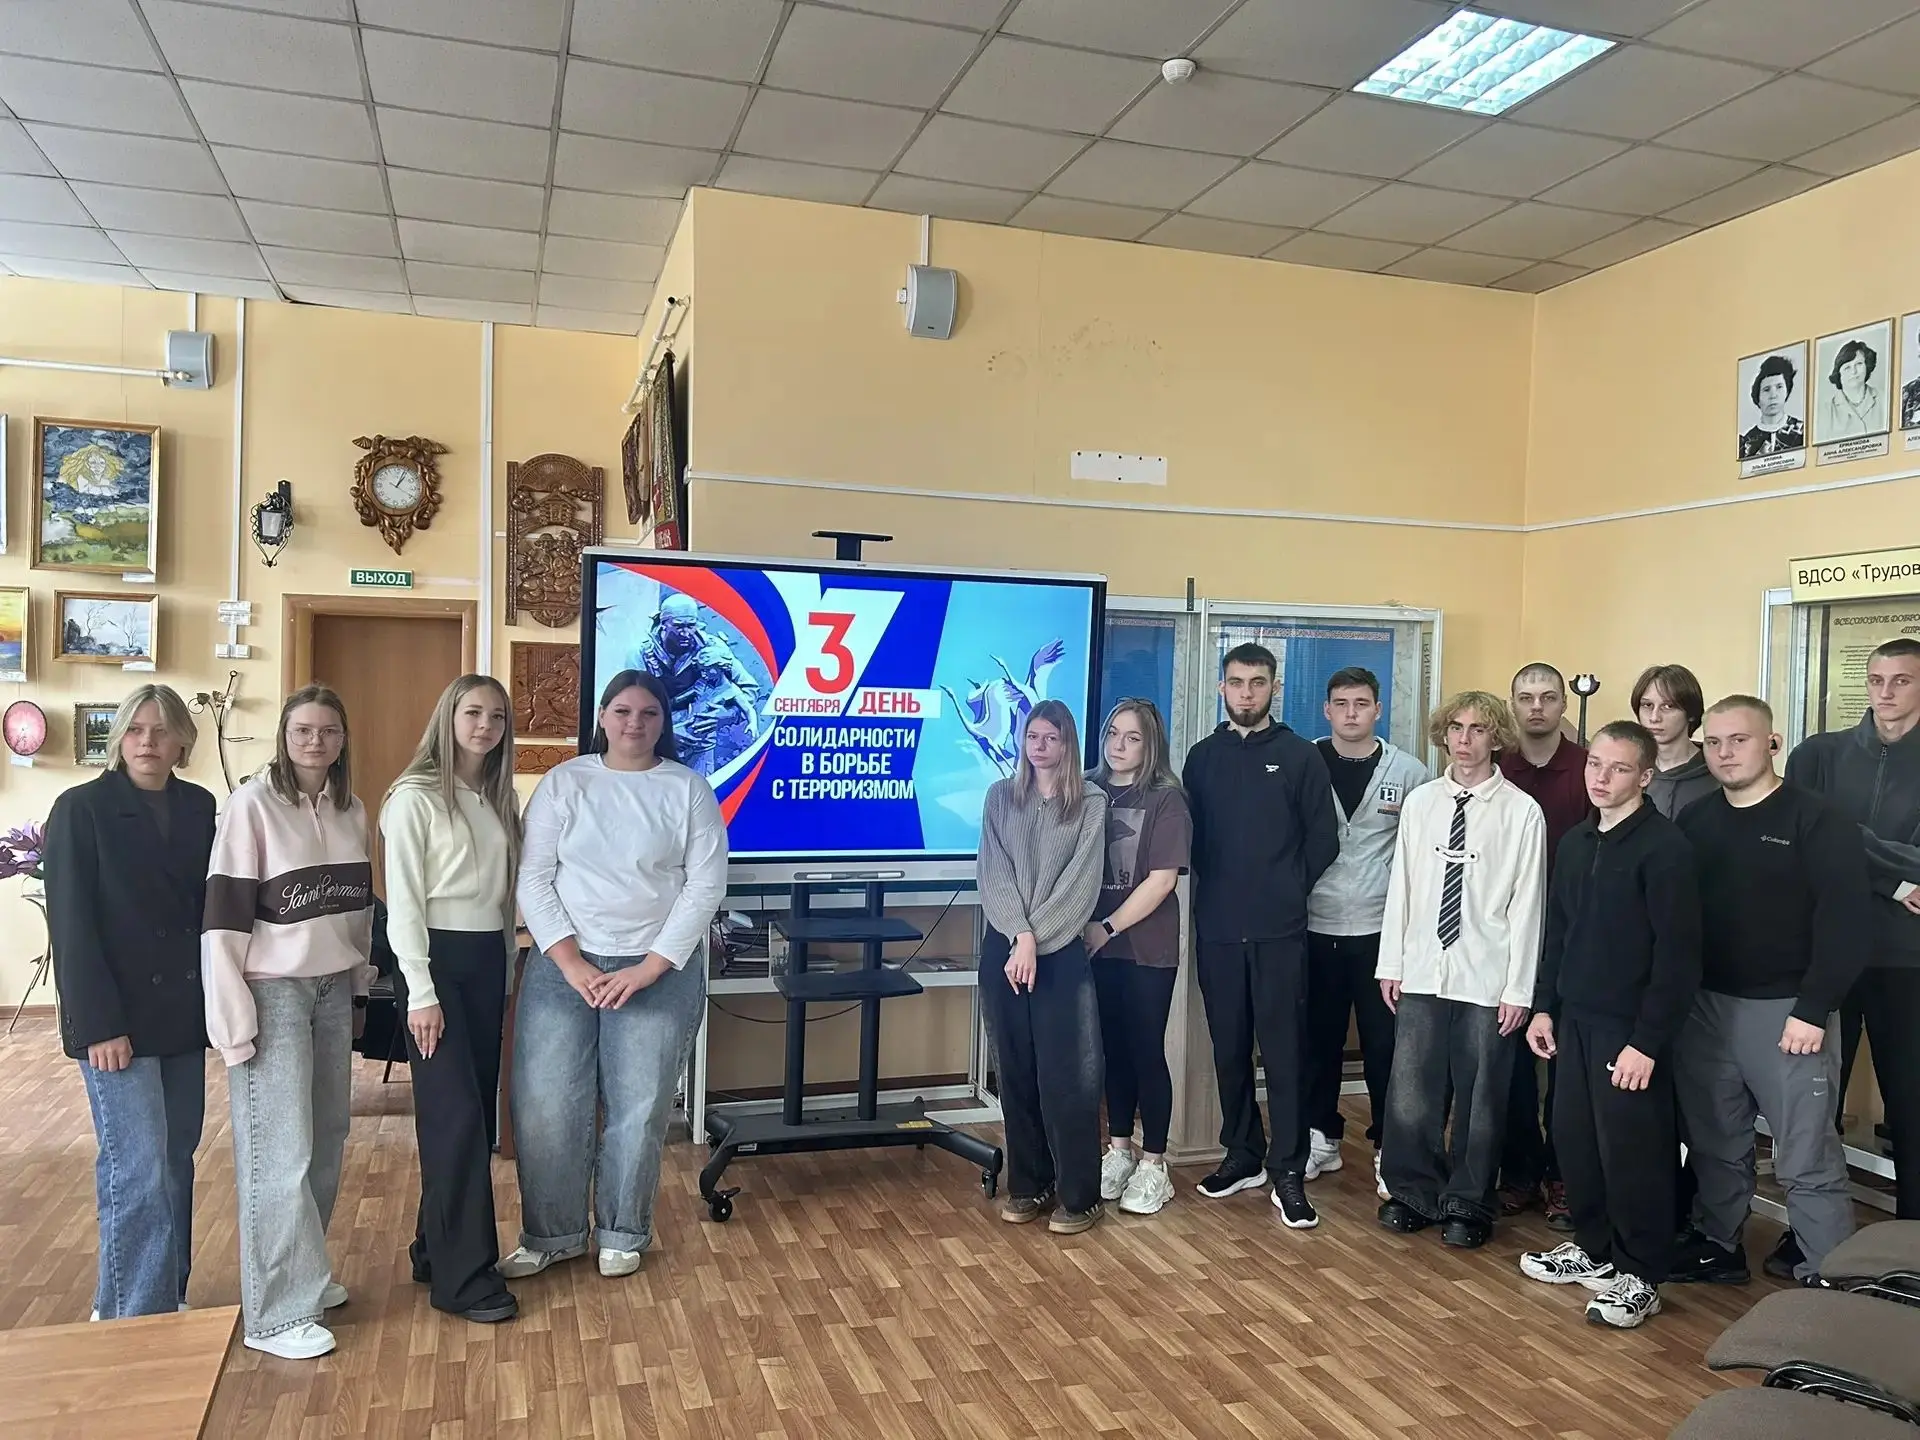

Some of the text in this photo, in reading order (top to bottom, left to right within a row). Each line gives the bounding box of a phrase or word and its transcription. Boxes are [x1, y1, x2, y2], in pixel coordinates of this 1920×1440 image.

[1838, 443, 1883, 454] АЛЕКСАНДРОВНА
[356, 572, 407, 585] ВЫХОД
[1798, 566, 1846, 587] ВДСО
[1833, 615, 1890, 625] ВСЕСОЮЗНОЕ
[805, 611, 856, 694] 3
[774, 691, 921, 714] СЕНТЯБРЯ ДЕНЬ
[774, 726, 915, 749] СОЛИДАРНОСТИ
[801, 753, 892, 775] В БОРЬБЕ
[772, 779, 914, 800] С ТЕРРОРИЗМОМ
[280, 874, 369, 914] Saint Germain
